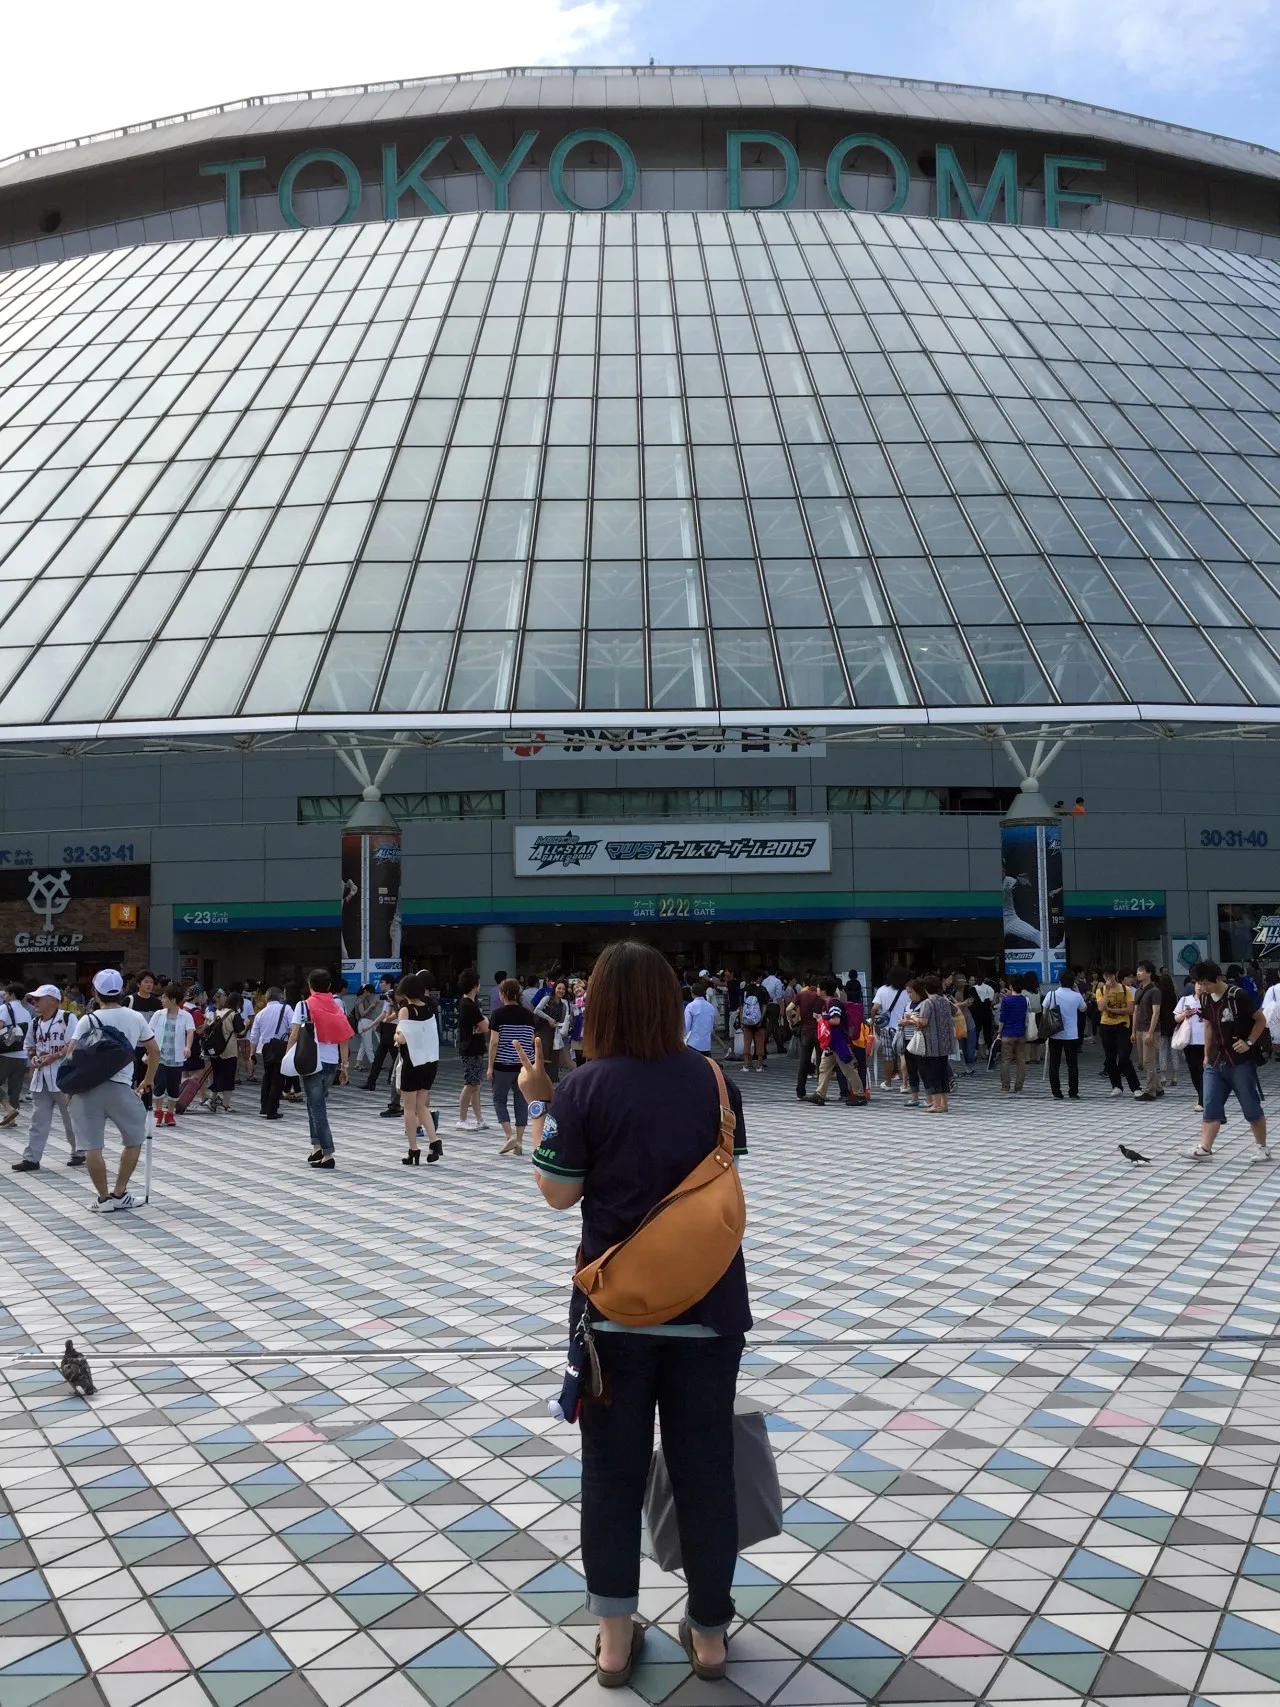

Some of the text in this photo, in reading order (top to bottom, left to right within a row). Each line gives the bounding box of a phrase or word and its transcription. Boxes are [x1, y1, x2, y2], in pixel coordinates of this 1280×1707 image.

[199, 128, 637, 235] TOKYO
[633, 900, 655, 908] ゲート
[693, 899, 715, 908] ゲート
[1130, 899, 1146, 911] 21
[633, 909, 656, 917] GATE
[693, 908, 716, 916] GATE
[194, 912, 211, 924] 23
